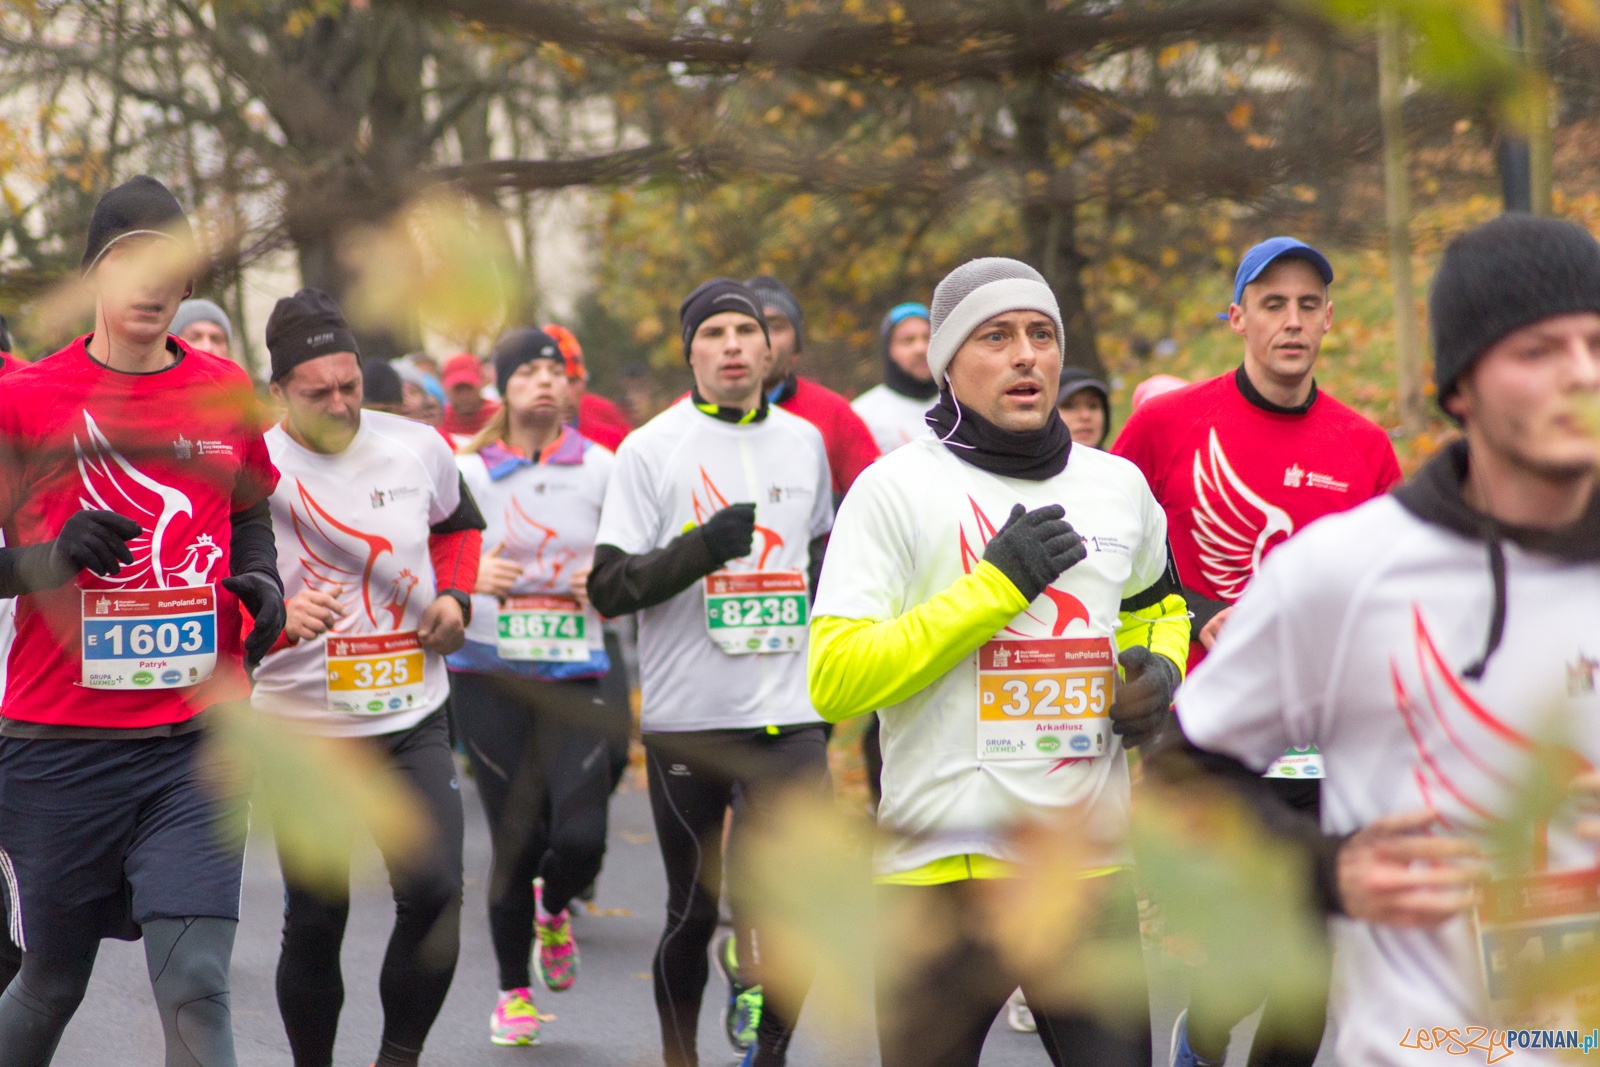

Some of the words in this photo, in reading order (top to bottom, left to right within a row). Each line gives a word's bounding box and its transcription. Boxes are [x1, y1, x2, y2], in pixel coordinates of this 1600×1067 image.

[158, 598, 207, 608] RunPoland.org
[721, 598, 799, 626] 8238
[509, 615, 577, 637] 8674
[88, 635, 97, 646] E
[104, 621, 203, 655] 1603
[1014, 650, 1021, 663] 1
[1065, 651, 1109, 660] RunPoland.org
[139, 661, 167, 669] Patryk
[353, 658, 408, 688] 325
[983, 691, 996, 705] D
[1001, 676, 1106, 717] 3255
[1035, 723, 1083, 731] Arkadiusz
